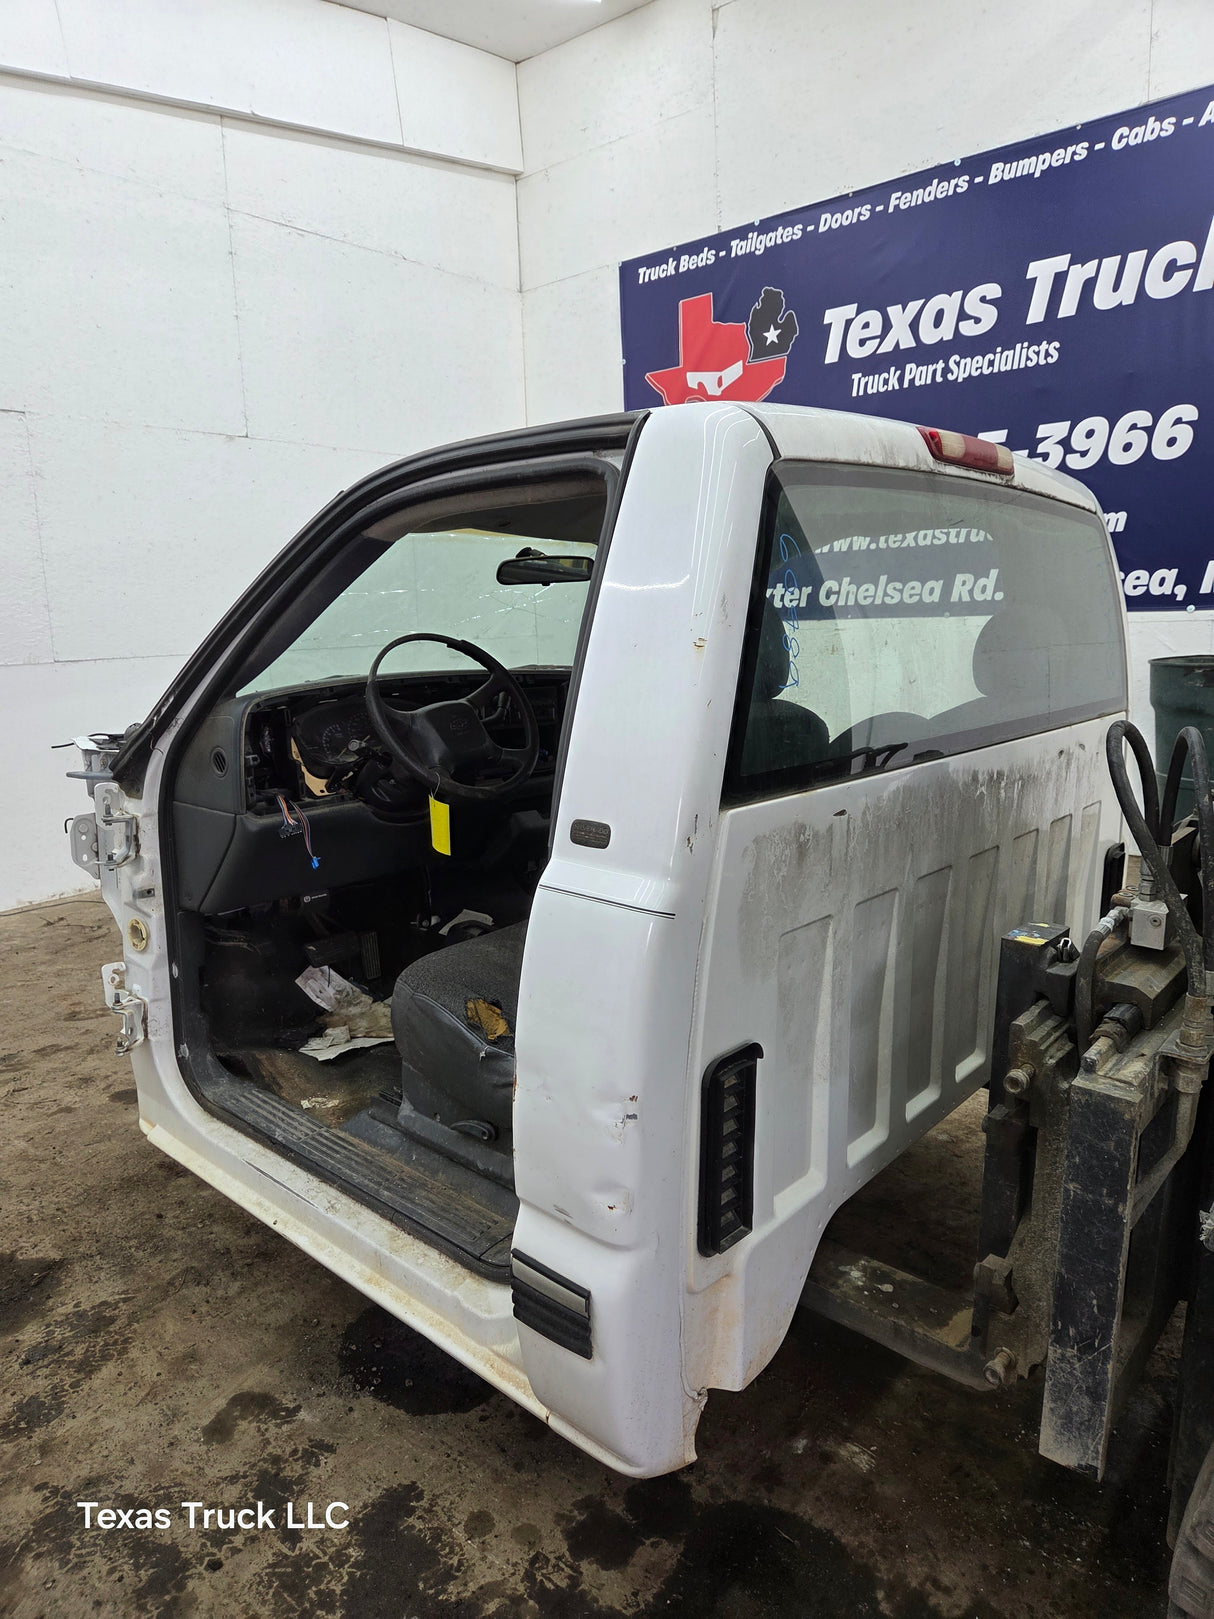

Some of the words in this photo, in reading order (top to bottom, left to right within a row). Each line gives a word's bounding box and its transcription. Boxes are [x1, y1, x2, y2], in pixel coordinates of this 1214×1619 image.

[638, 258, 676, 284] Truck
[679, 247, 716, 273] Beds
[730, 222, 803, 258] Tailgates
[818, 203, 871, 233] Doors
[888, 173, 970, 213] Fenders
[988, 140, 1089, 185] Bumpers
[1111, 116, 1177, 150] Cabs
[823, 282, 1002, 365] Texas
[851, 367, 901, 397] Truck
[902, 360, 946, 388] Part
[947, 340, 1061, 383] Specialists
[819, 574, 944, 607] Chelsea
[950, 568, 1005, 603] Rd.
